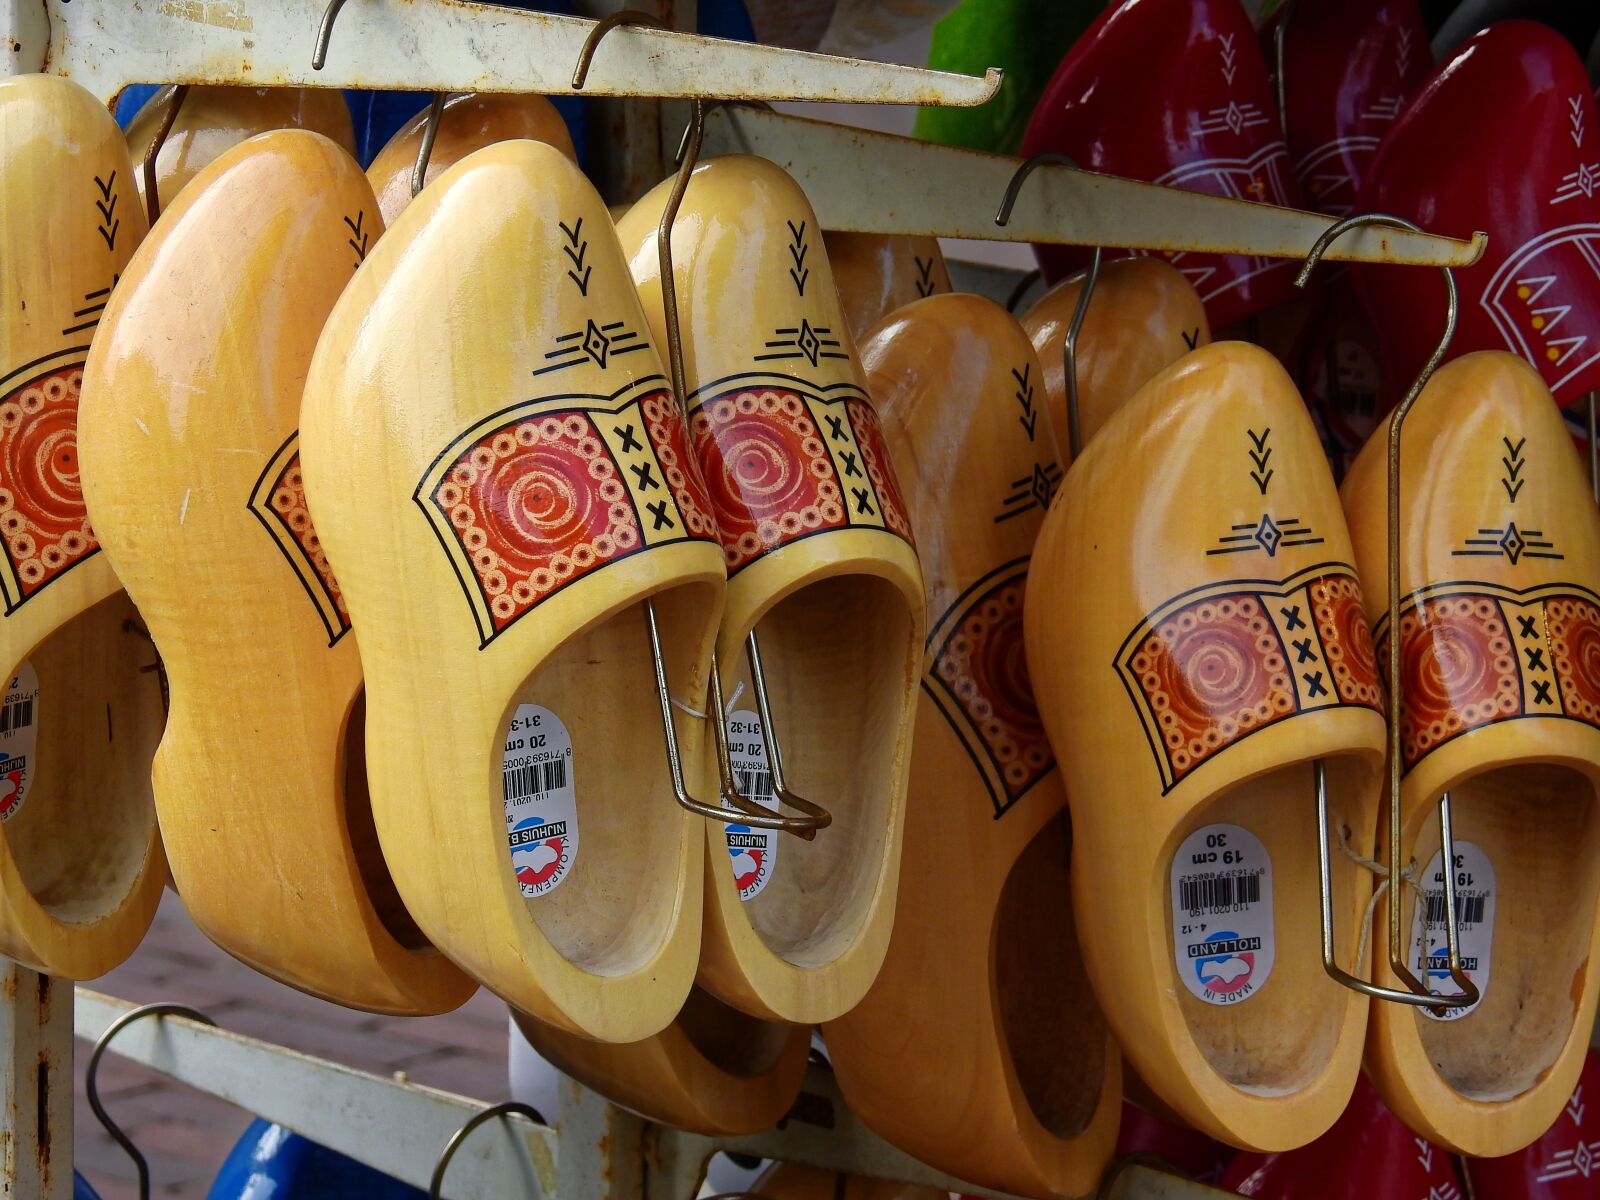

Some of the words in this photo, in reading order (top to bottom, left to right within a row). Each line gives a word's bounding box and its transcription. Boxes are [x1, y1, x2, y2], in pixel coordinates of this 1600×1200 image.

[509, 715, 541, 731] 31-3
[731, 722, 760, 734] 31-32
[505, 739, 524, 752] cm
[530, 734, 546, 748] 20
[729, 743, 744, 752] cm
[748, 744, 761, 756] 20
[522, 823, 564, 842] NIJHUIS
[730, 835, 765, 847] NIJHUIS
[1206, 834, 1226, 848] 30
[1192, 852, 1217, 864] cm
[1223, 850, 1243, 864] 19
[1452, 855, 1464, 868] 3
[518, 835, 569, 894] KLOMPENFA
[1458, 873, 1473, 886] 19
[1182, 925, 1192, 934] 12
[1201, 924, 1207, 932] 4
[1189, 938, 1259, 956] HOLLAND
[1419, 958, 1476, 969] HOLAN
[1203, 989, 1215, 1000] IN
[1220, 983, 1252, 1002] MADE
